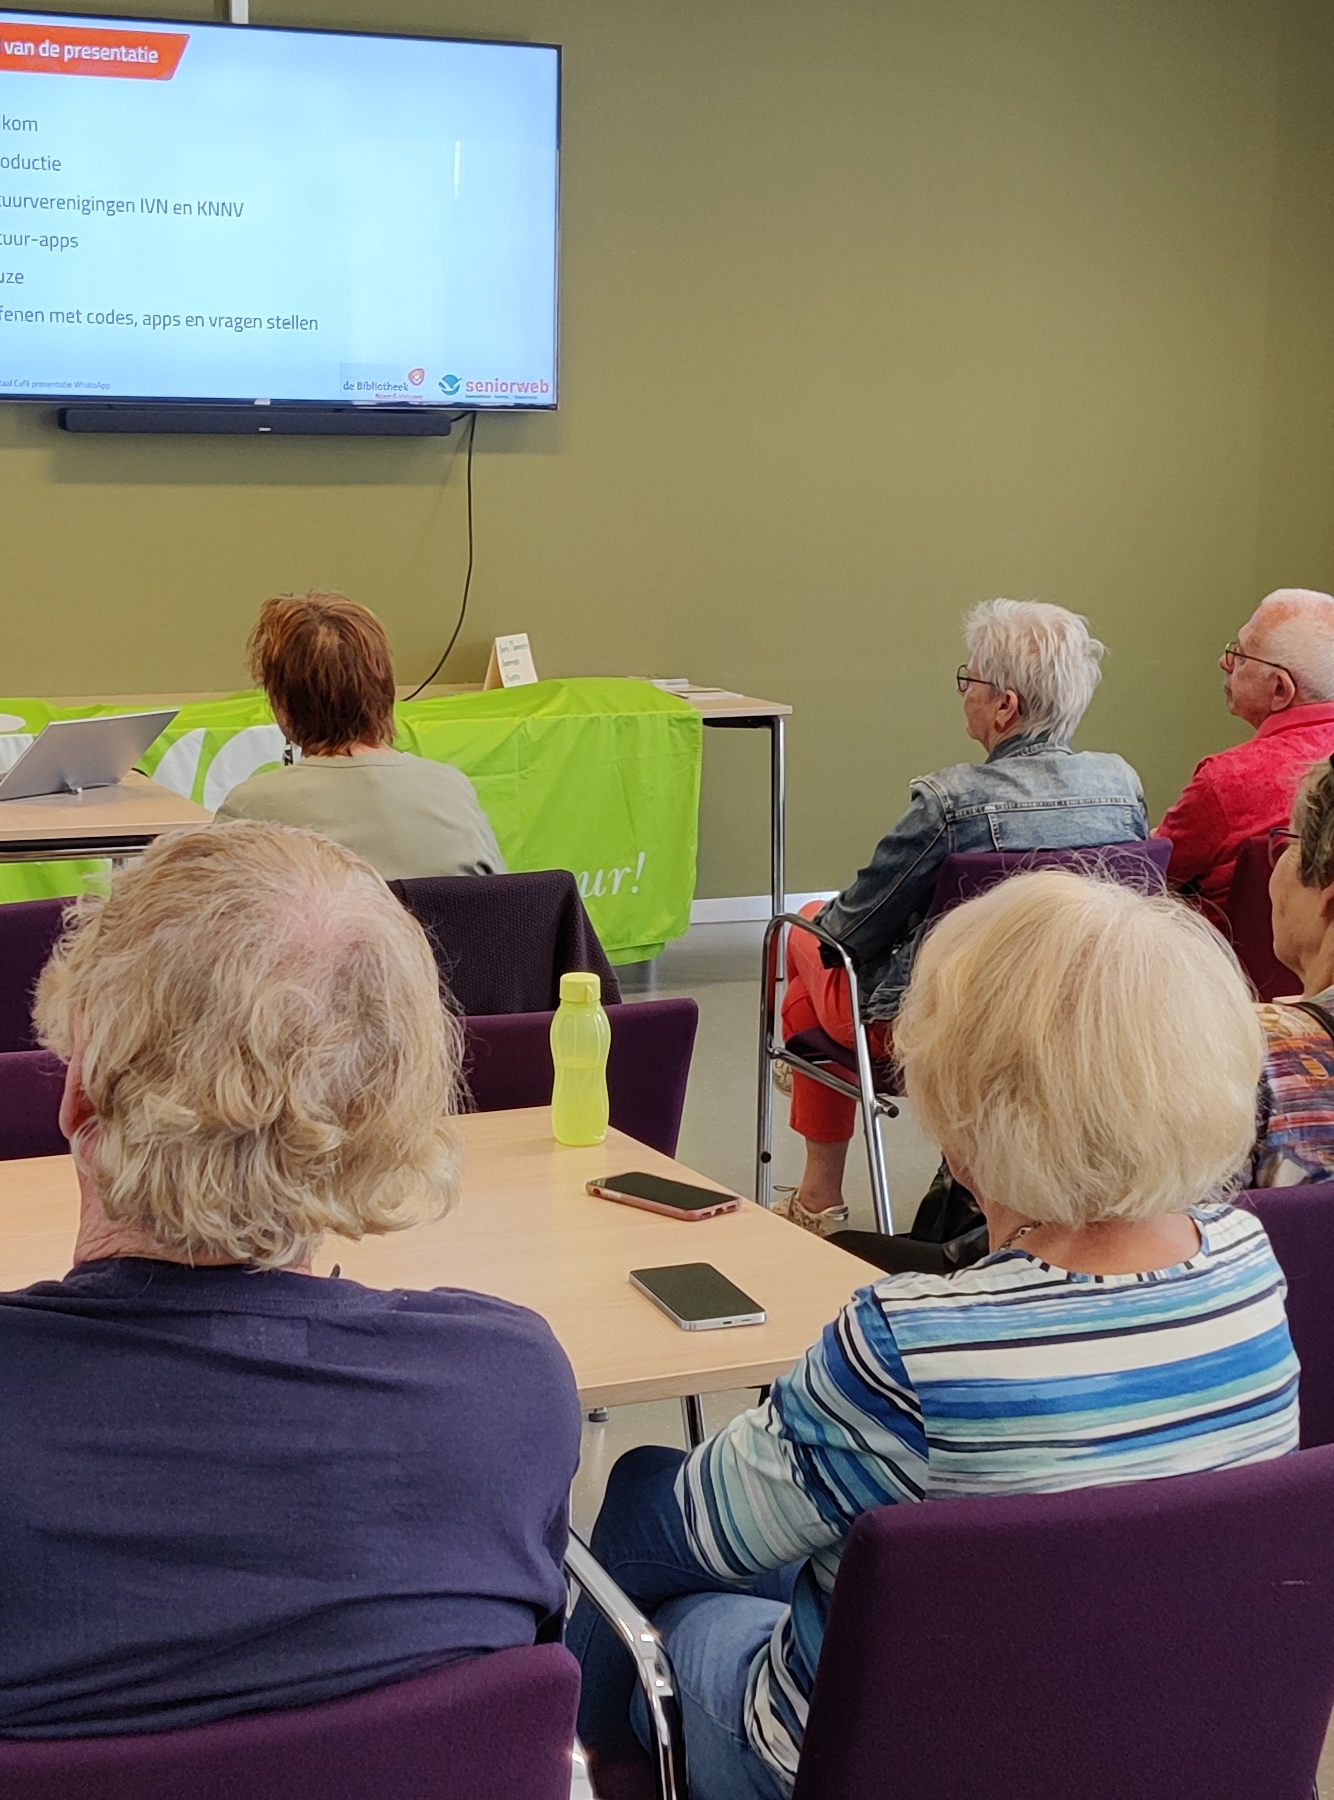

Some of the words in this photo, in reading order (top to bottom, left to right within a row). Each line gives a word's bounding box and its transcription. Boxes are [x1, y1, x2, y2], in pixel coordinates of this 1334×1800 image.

[4, 42, 35, 56] van
[38, 39, 60, 57] de
[63, 44, 159, 63] presentatie
[140, 198, 169, 215] IVN
[173, 203, 193, 216] en
[197, 201, 245, 218] KNNV
[49, 309, 83, 325] met
[86, 309, 139, 328] codes,
[142, 313, 181, 331] apps
[185, 314, 206, 328] en
[208, 315, 263, 333] vragen
[267, 313, 320, 331] stellen
[356, 381, 409, 392] Bibliotheek
[465, 377, 550, 394] seniorweb
